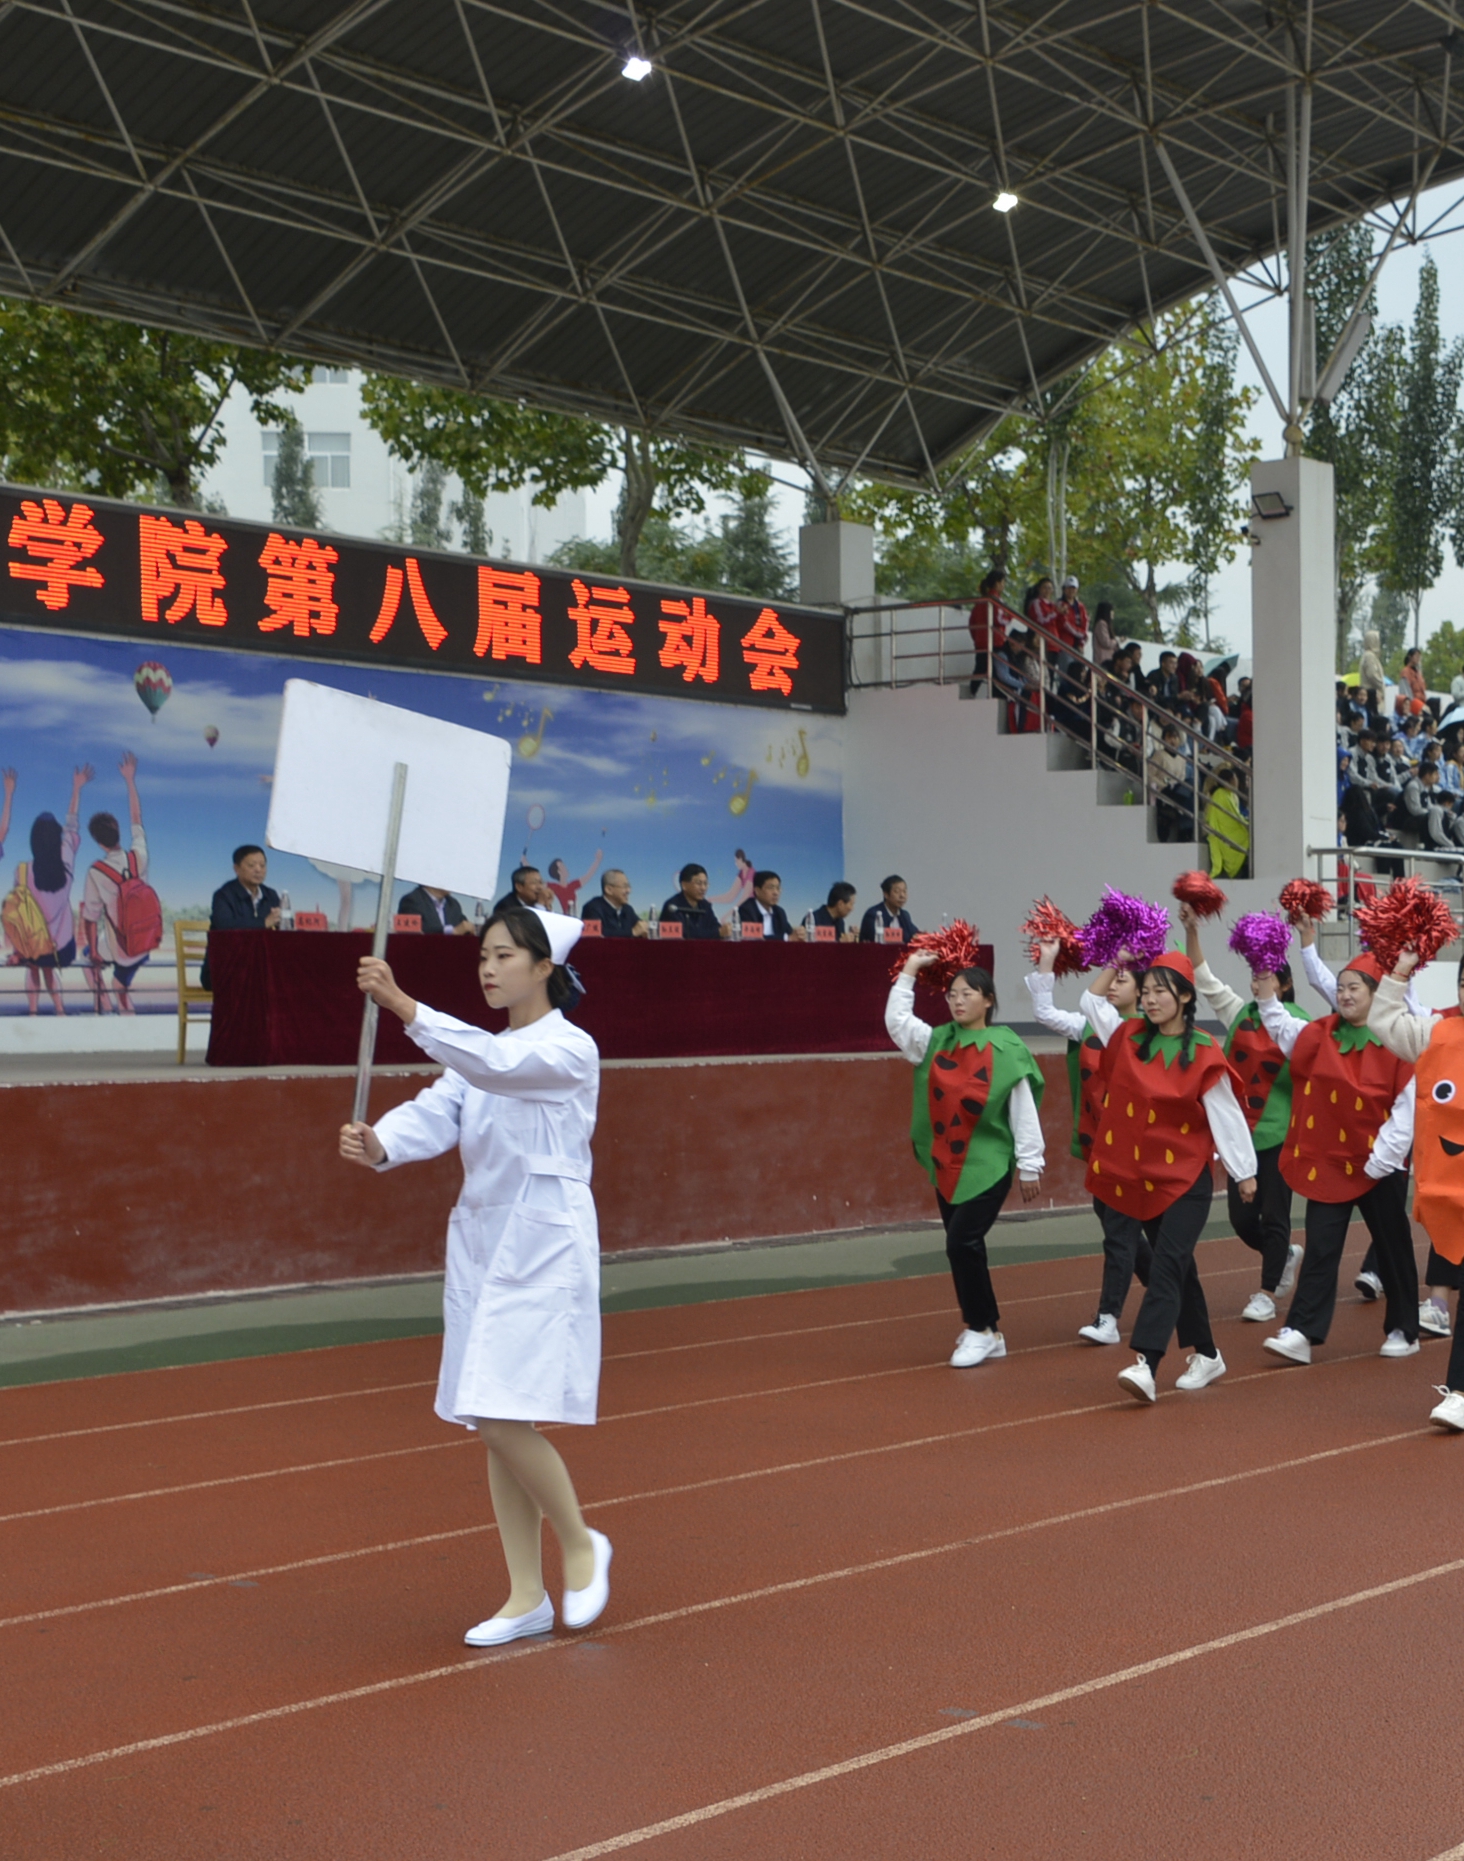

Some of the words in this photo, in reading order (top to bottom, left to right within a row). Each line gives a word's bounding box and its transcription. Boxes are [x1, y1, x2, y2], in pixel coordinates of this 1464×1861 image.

[8, 498, 802, 697] 学院第八届运动会
